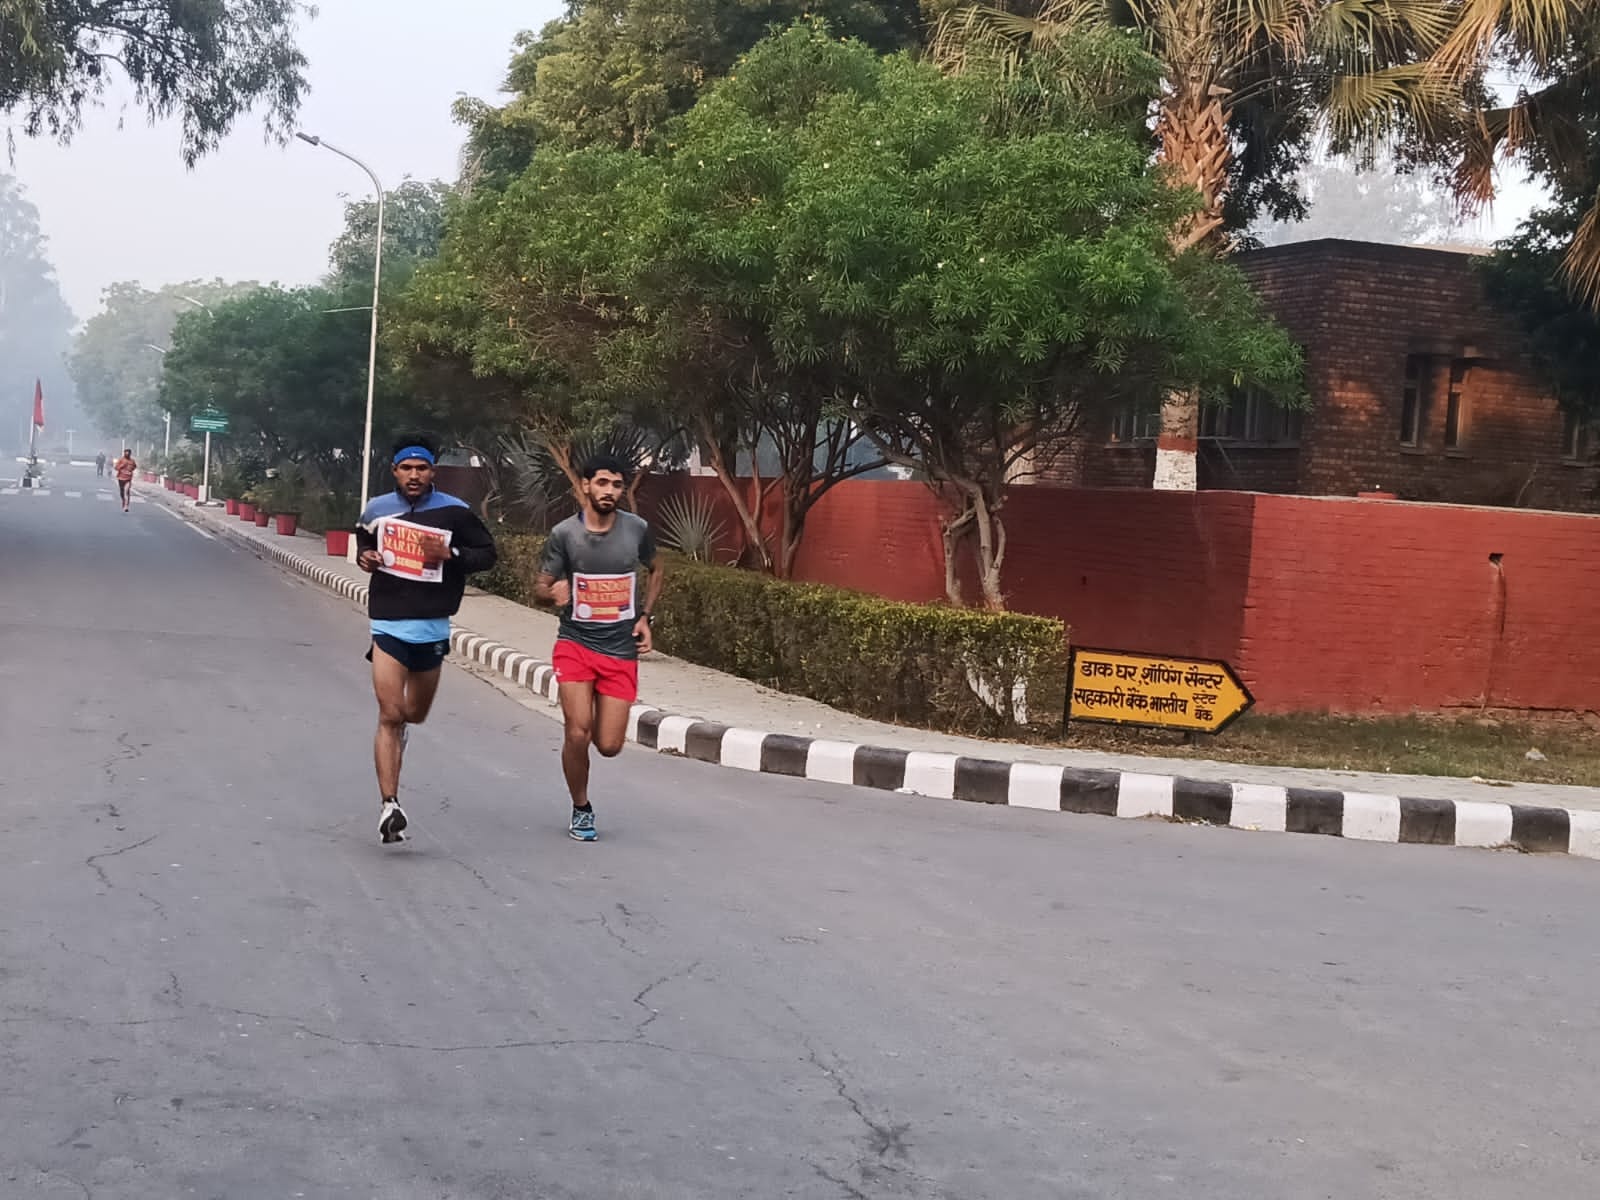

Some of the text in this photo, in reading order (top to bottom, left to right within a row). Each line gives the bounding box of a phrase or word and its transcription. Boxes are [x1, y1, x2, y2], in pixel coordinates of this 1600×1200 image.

[396, 526, 444, 545] WIS
[383, 535, 425, 557] MARATH
[1081, 660, 1114, 678] डाक
[1073, 685, 1126, 710] सहकारी
